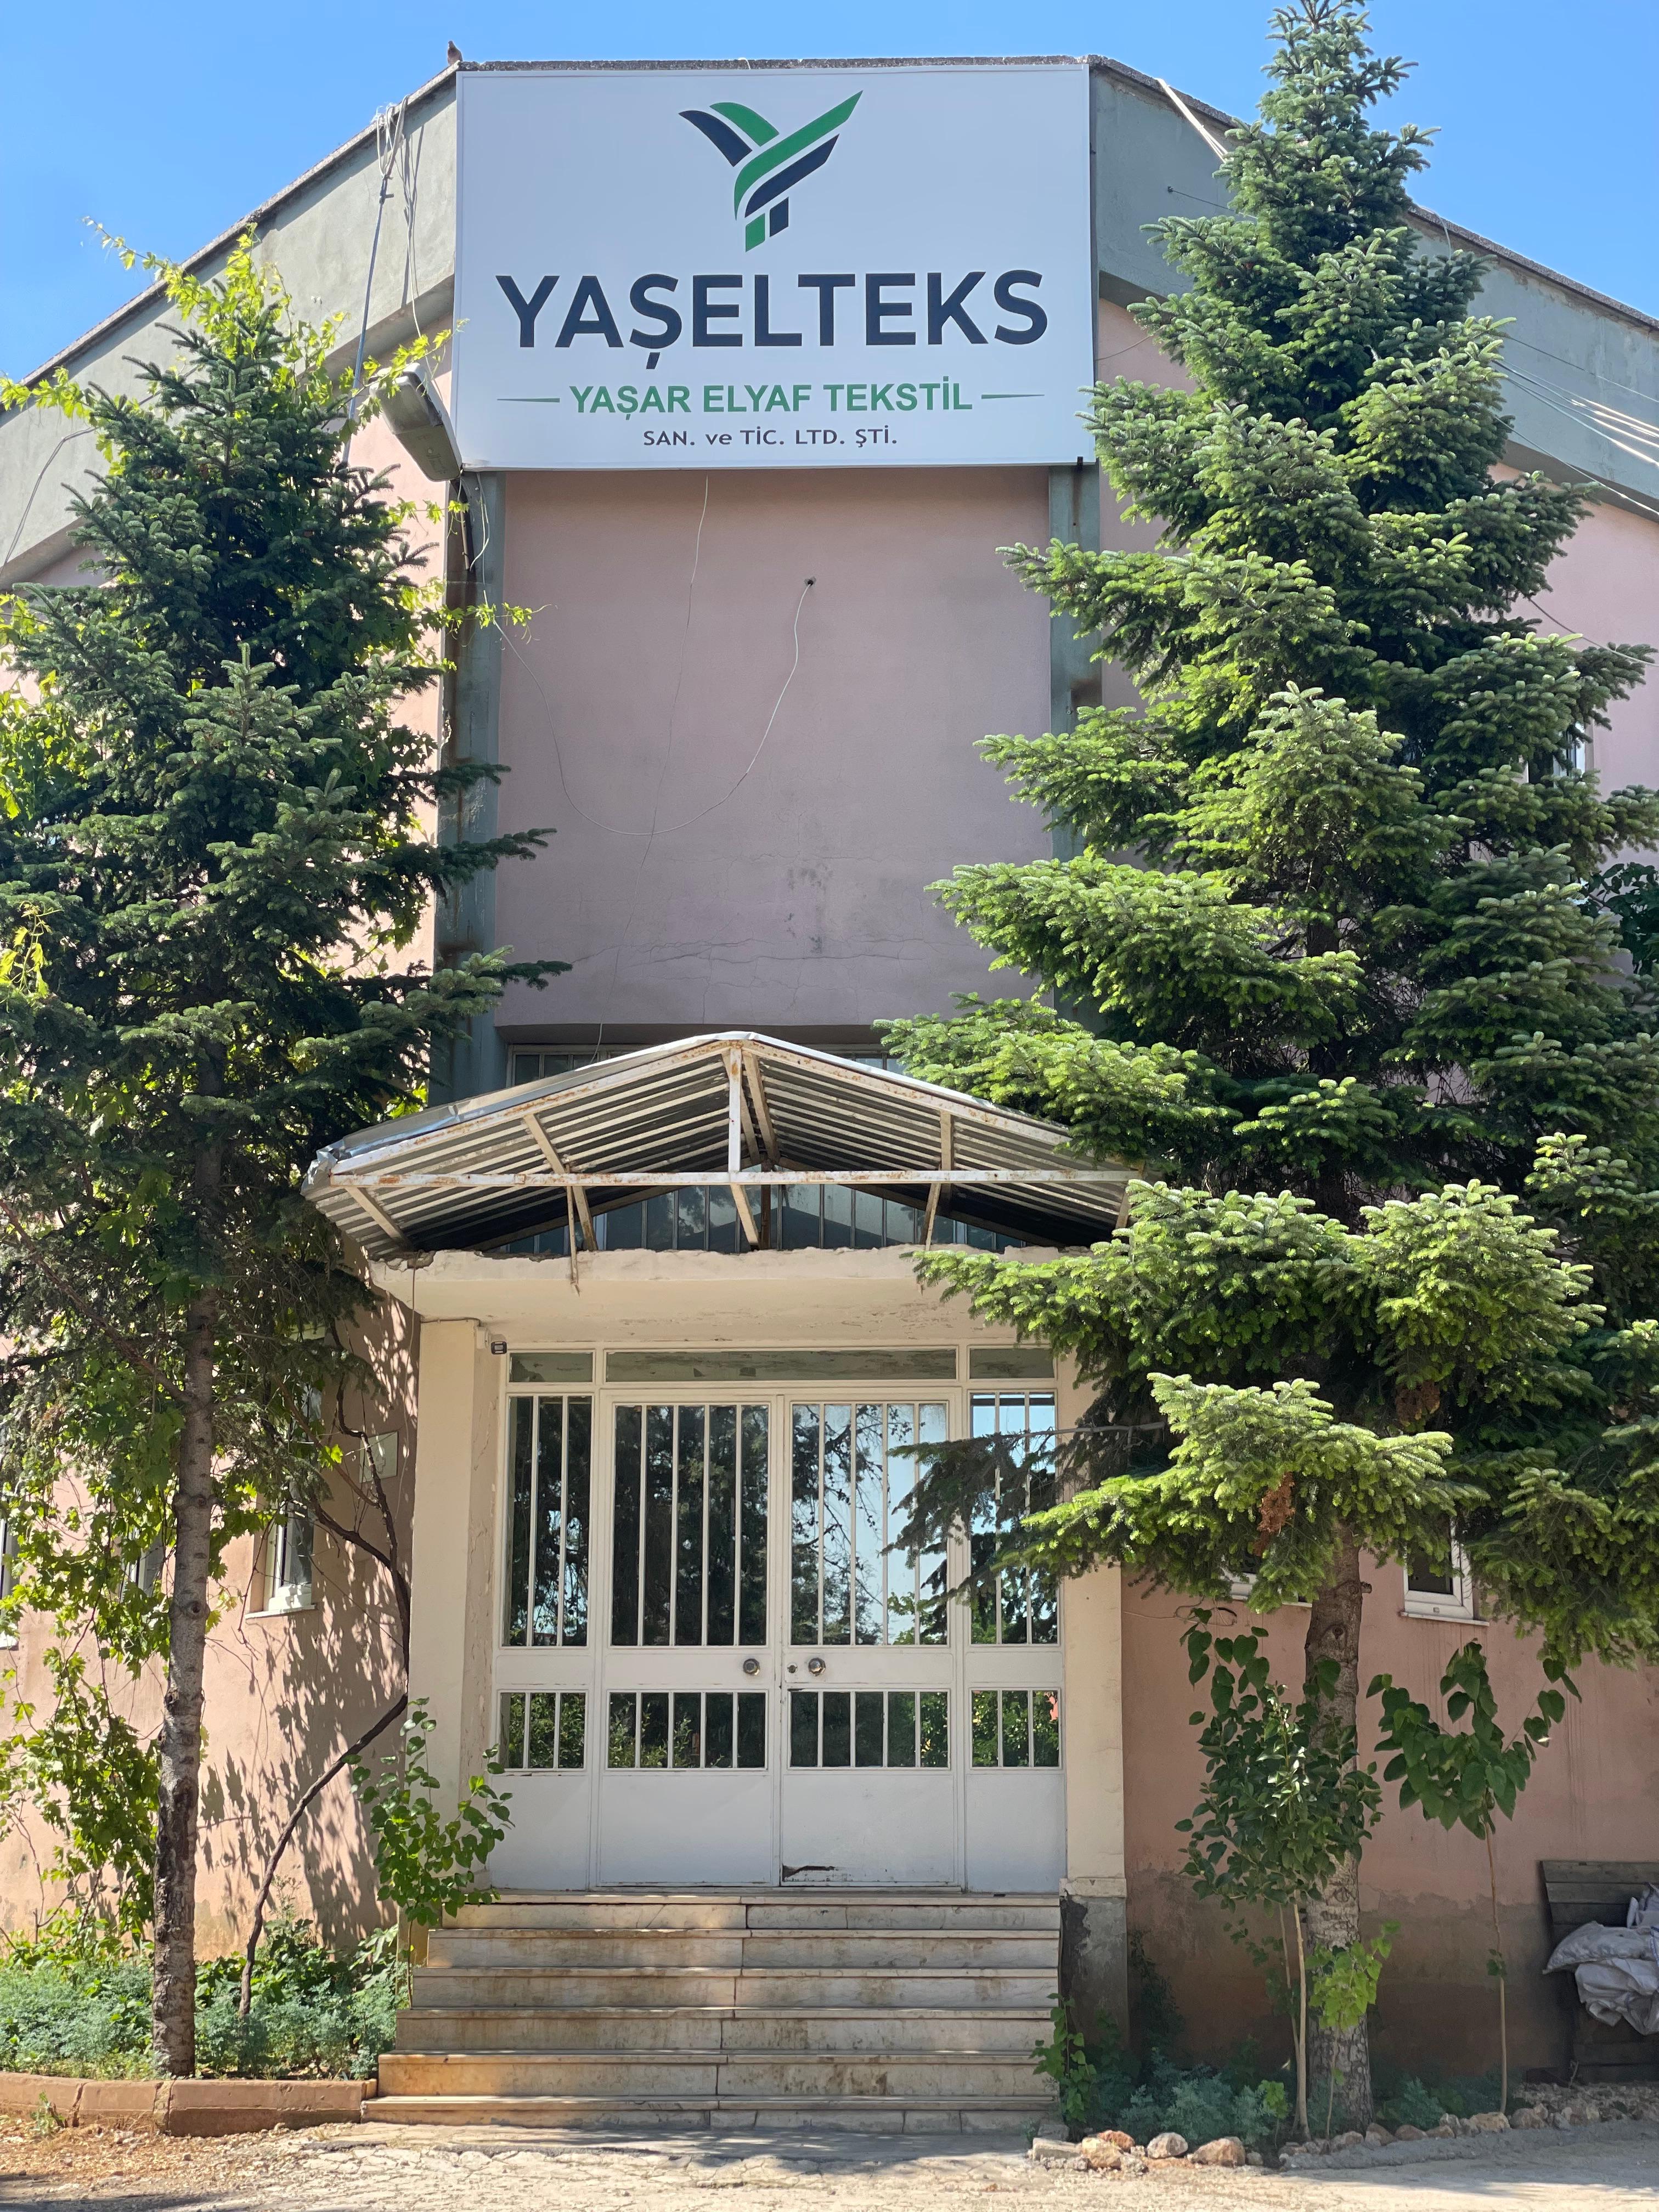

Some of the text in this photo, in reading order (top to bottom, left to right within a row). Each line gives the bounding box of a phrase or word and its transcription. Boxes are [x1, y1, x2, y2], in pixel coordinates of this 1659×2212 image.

[495, 269, 1048, 370] YAŞELTEKS
[568, 375, 973, 421] YAŞAR ELYAF TEKSTİL
[644, 425, 897, 448] SAN. ve TİC. LTD. ŞTİ.
